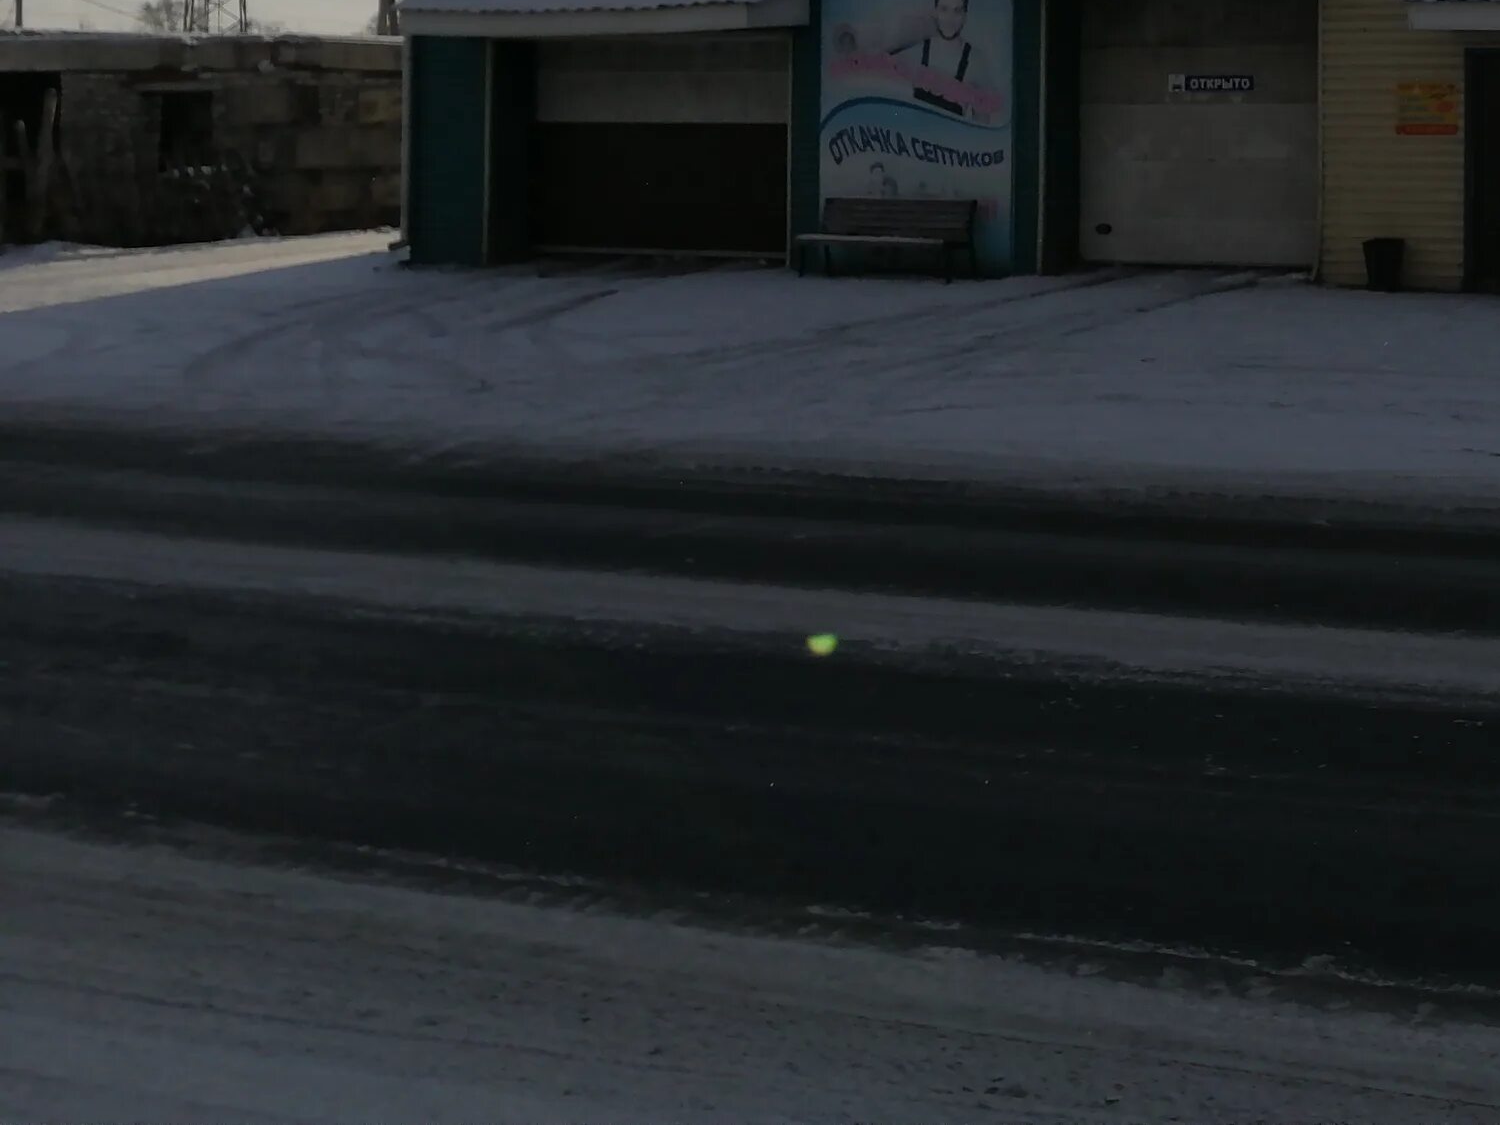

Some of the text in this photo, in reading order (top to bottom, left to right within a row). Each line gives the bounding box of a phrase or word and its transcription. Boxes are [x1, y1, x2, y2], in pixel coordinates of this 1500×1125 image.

[1190, 78, 1250, 89] ОТКРЫТО
[828, 125, 1004, 167] ОТКАЧКА СЕПТИКОВ
